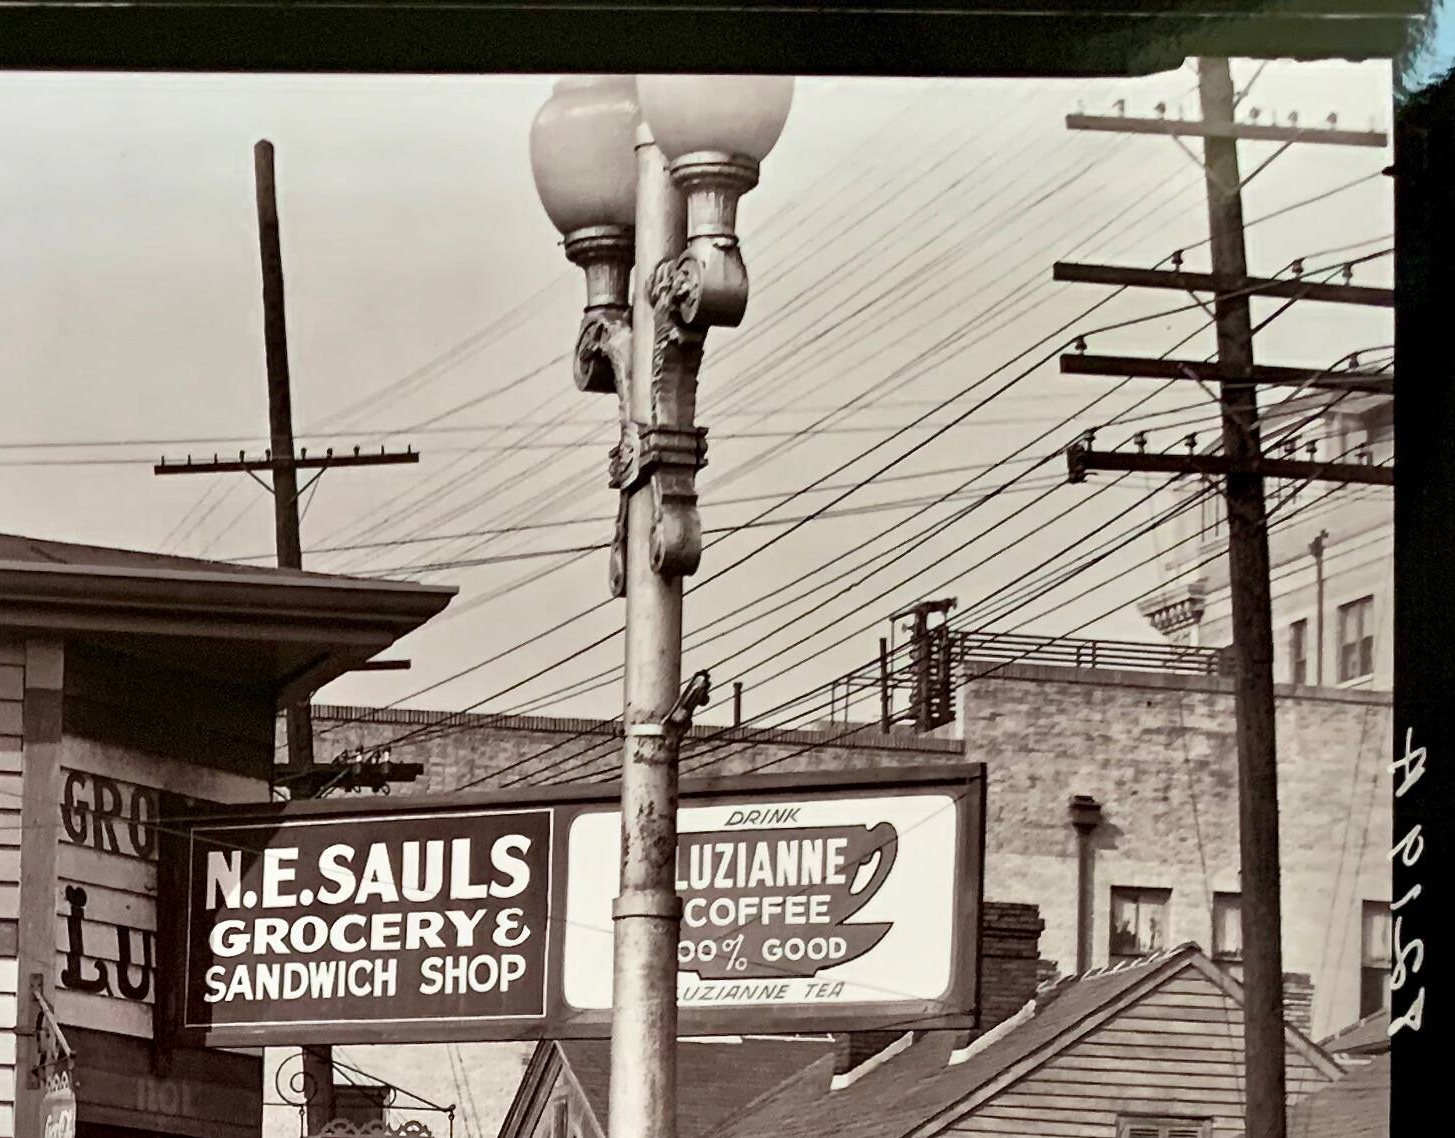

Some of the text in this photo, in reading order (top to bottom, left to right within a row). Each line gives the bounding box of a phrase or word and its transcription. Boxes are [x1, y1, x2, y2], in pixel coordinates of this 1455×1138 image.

[724, 808, 802, 827] DRINK
[684, 894, 831, 928] COFFEE
[209, 907, 531, 958] GROCERY &
[677, 933, 847, 971] 00% GOOD
[203, 953, 527, 1003] SANDWICH SHOP
[682, 981, 846, 1001] UZIANNE TEA
